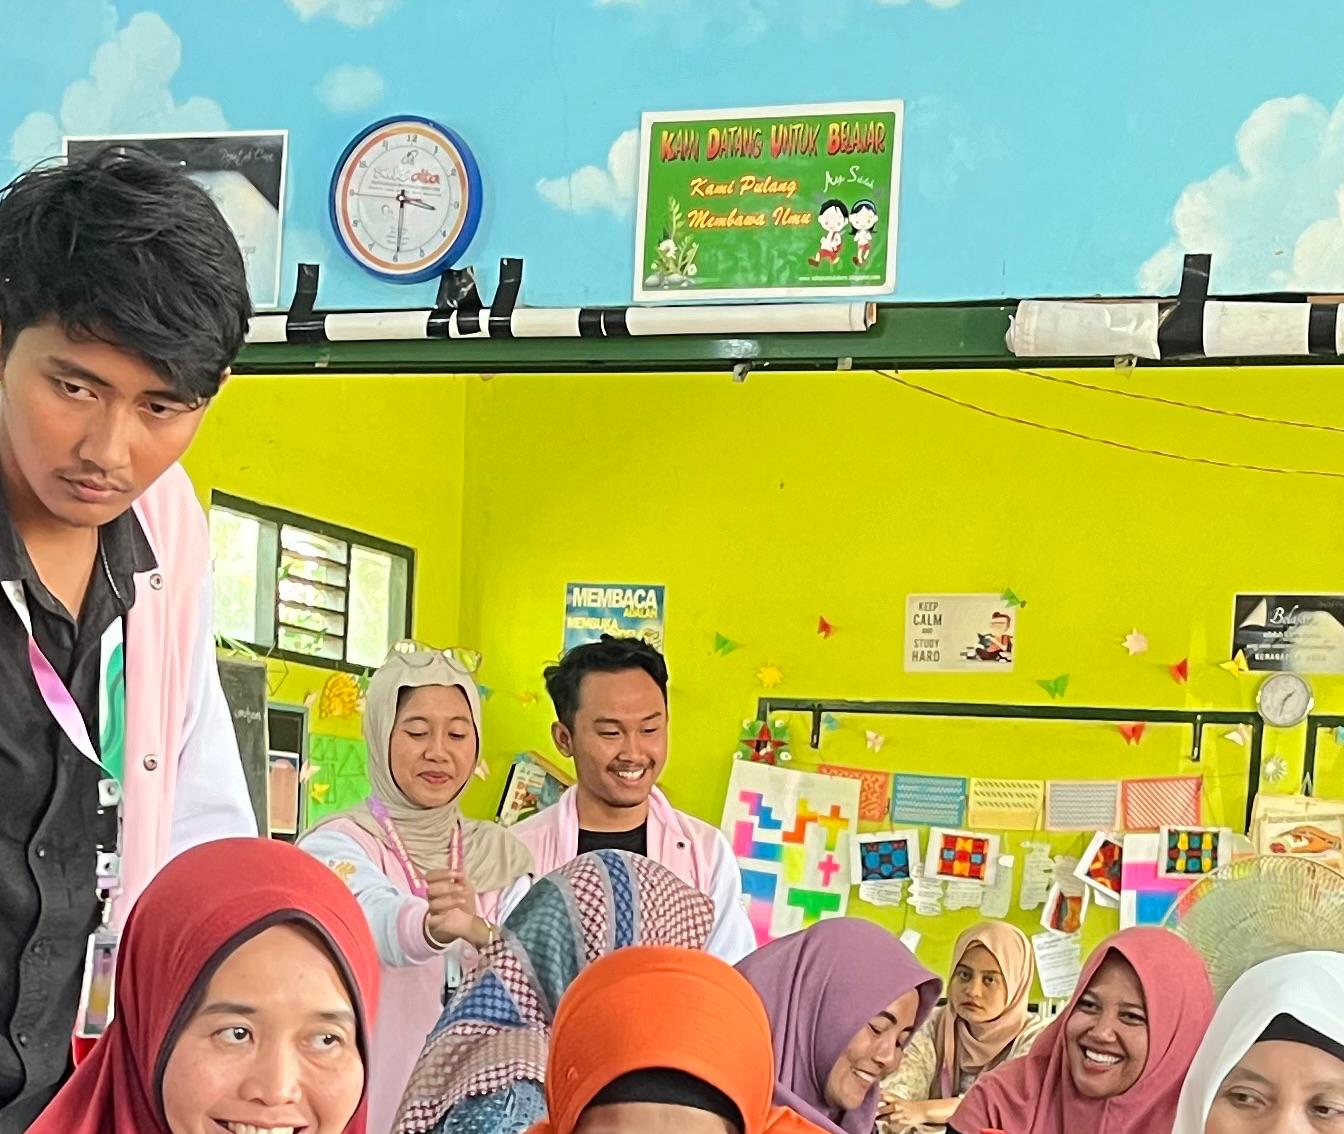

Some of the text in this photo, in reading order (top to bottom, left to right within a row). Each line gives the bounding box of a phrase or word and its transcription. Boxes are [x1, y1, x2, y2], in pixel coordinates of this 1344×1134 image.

[705, 127, 763, 161] DATANG
[771, 124, 821, 158] UNTUK
[827, 121, 886, 156] BELAJAR
[690, 175, 798, 198] Kami Pulang
[687, 206, 812, 229] Membawa Ilmu
[572, 587, 657, 609] MEMBACA
[918, 601, 939, 612] KEEP
[913, 614, 942, 626] CALM
[914, 638, 940, 648] STUDY
[912, 650, 940, 662] HARD
